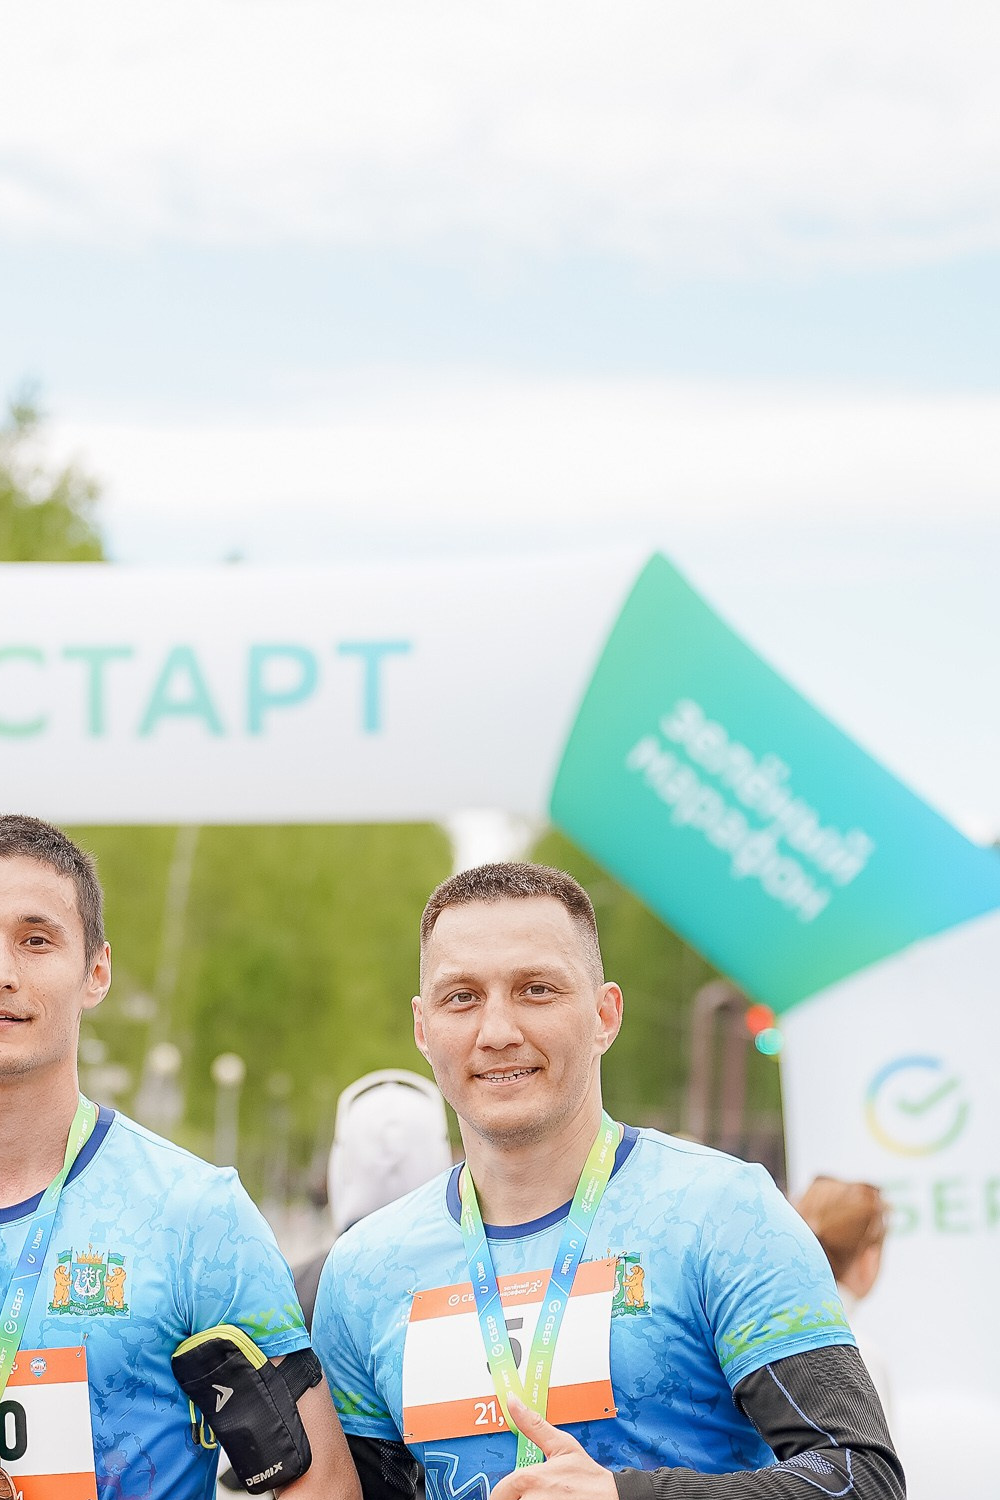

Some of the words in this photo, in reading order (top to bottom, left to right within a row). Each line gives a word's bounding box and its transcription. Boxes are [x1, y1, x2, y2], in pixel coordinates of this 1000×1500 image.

[625, 734, 832, 924] марафон
[32, 1227, 44, 1249] Utair
[476, 1261, 486, 1283] Utair
[561, 1253, 575, 1276] Utair
[10, 1287, 25, 1318] СБЕР
[461, 1293, 476, 1303] СБ
[486, 1315, 500, 1343] СБЕР
[541, 1315, 556, 1346] СБЕР
[534, 1359, 543, 1380] 185
[531, 1381, 539, 1405] лет
[245, 1461, 283, 1487] DEMIX
